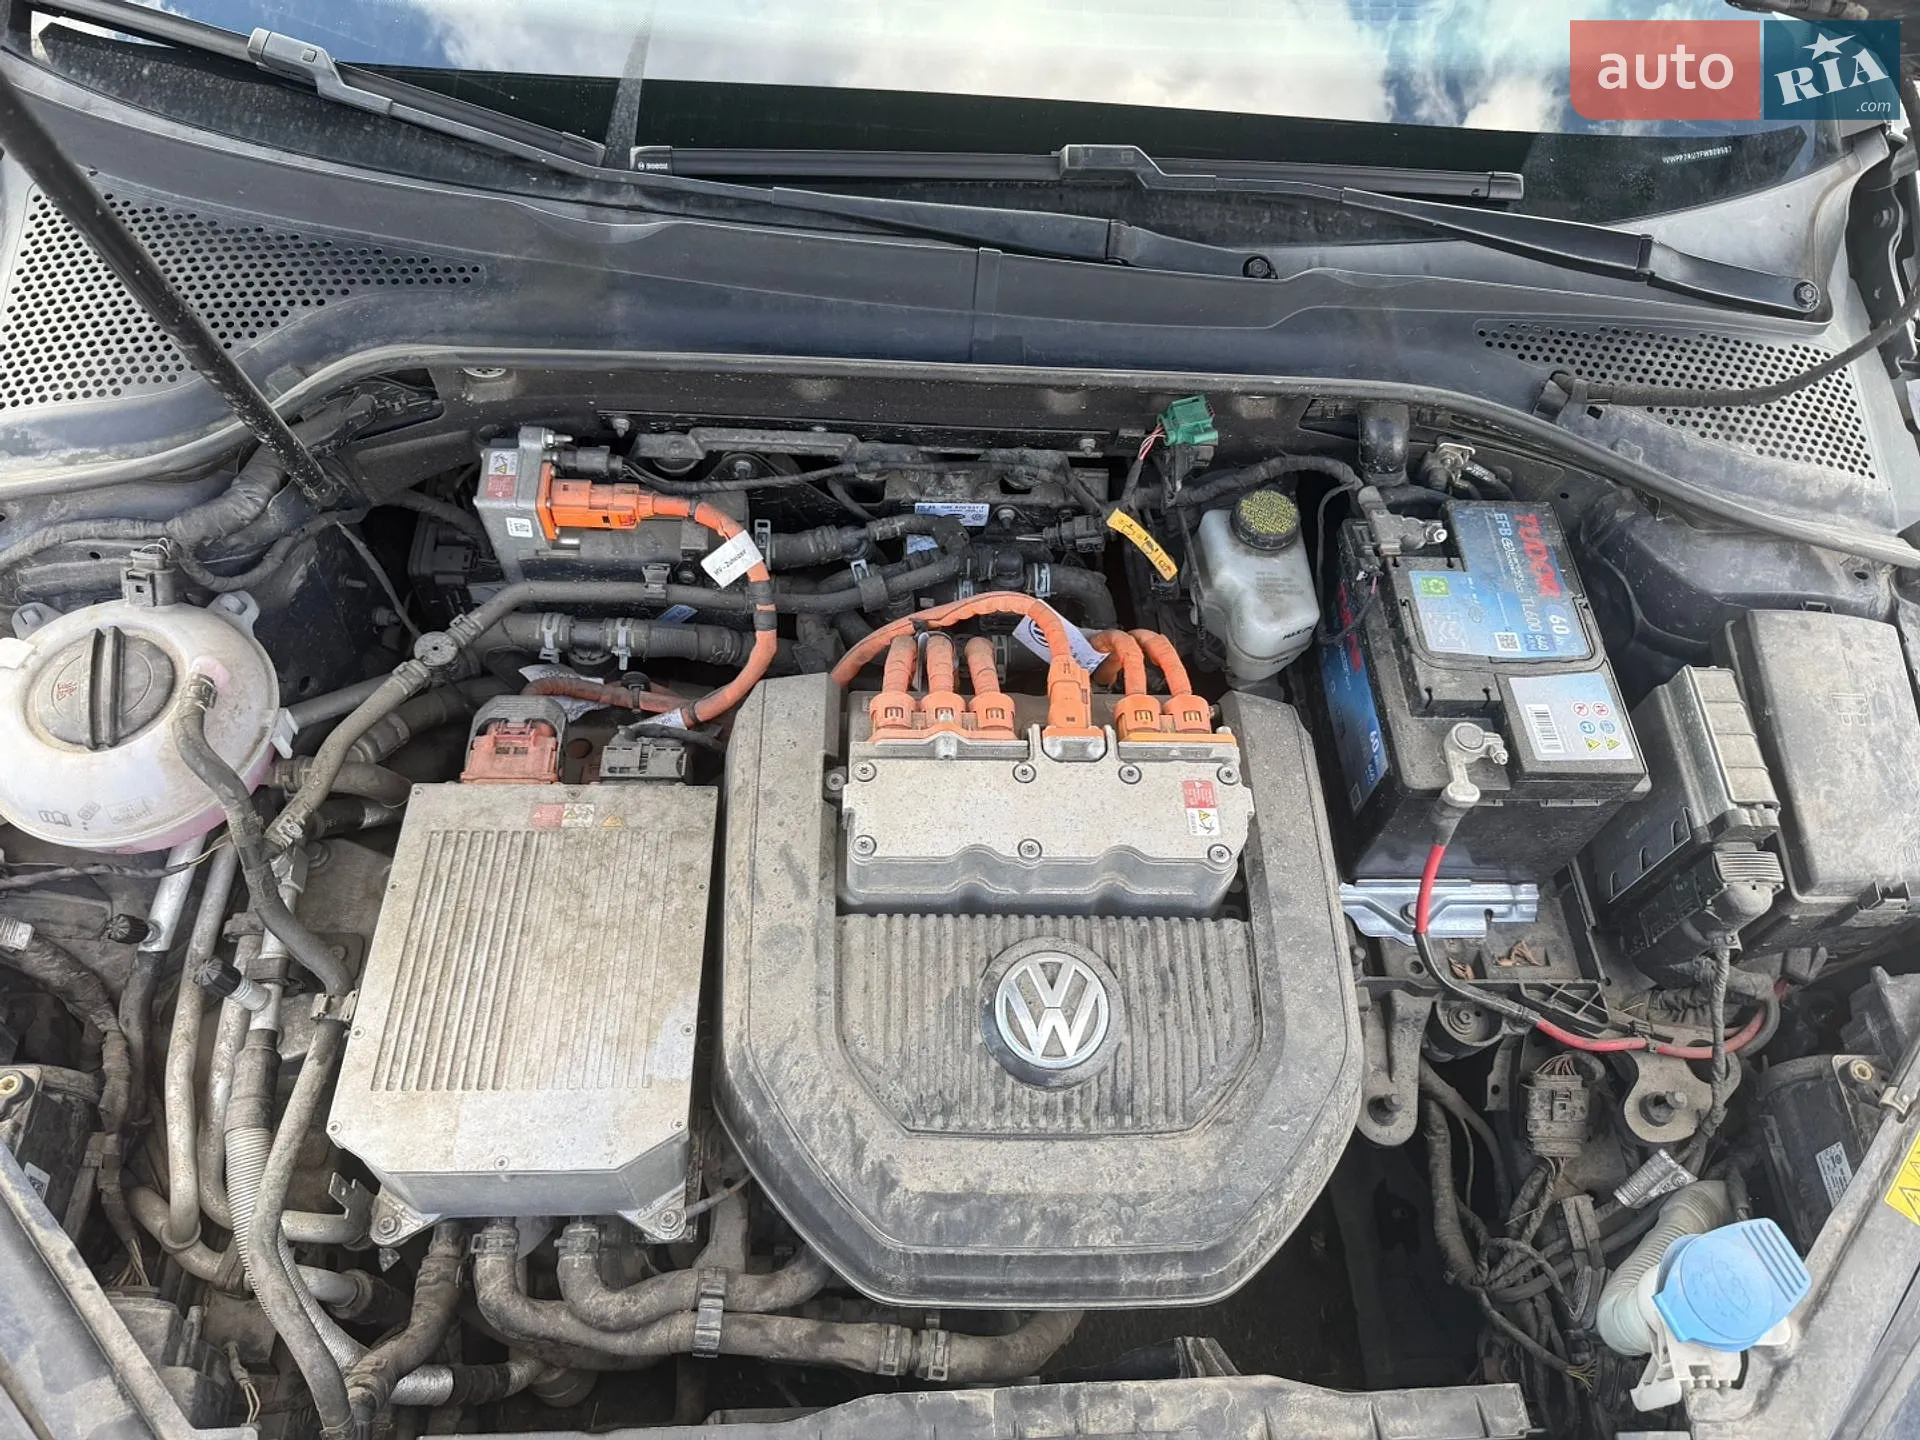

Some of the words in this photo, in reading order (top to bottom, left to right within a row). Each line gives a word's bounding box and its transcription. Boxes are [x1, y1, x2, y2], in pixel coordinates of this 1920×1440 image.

[1495, 512, 1513, 539] EFB
[1515, 512, 1561, 597] TUDOR
[1520, 596, 1544, 632] TL600
[1549, 614, 1570, 636] 60
[1534, 633, 1550, 652] 640
